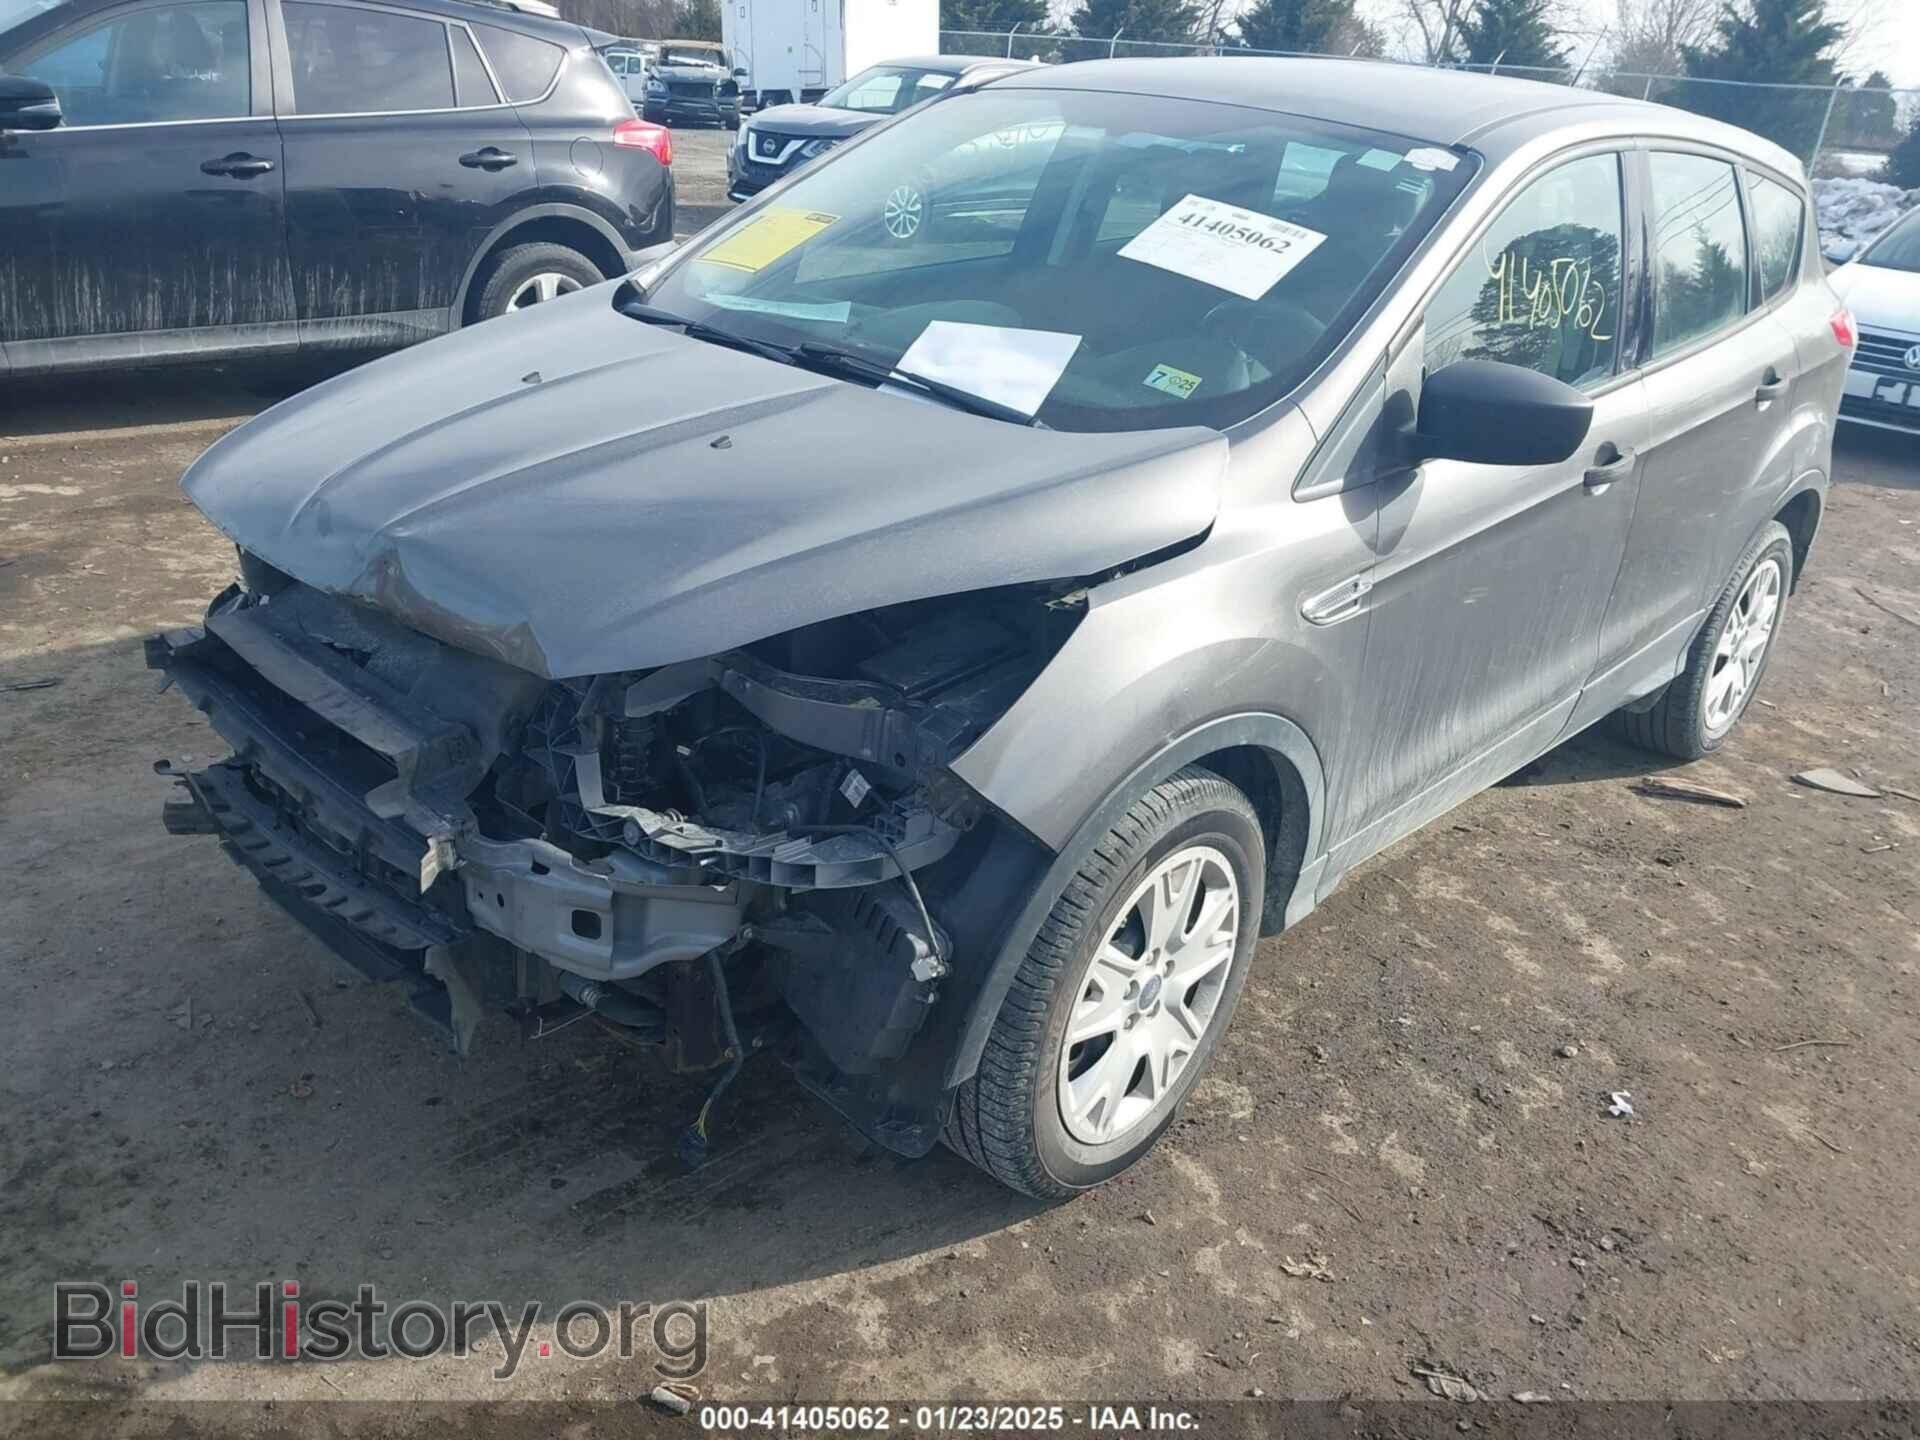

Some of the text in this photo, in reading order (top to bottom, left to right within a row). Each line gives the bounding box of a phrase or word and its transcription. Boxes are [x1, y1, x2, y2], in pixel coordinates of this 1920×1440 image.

[1178, 212, 1292, 255] 41405062
[1482, 240, 1613, 340] 41405062
[1152, 371, 1197, 391] 7 25
